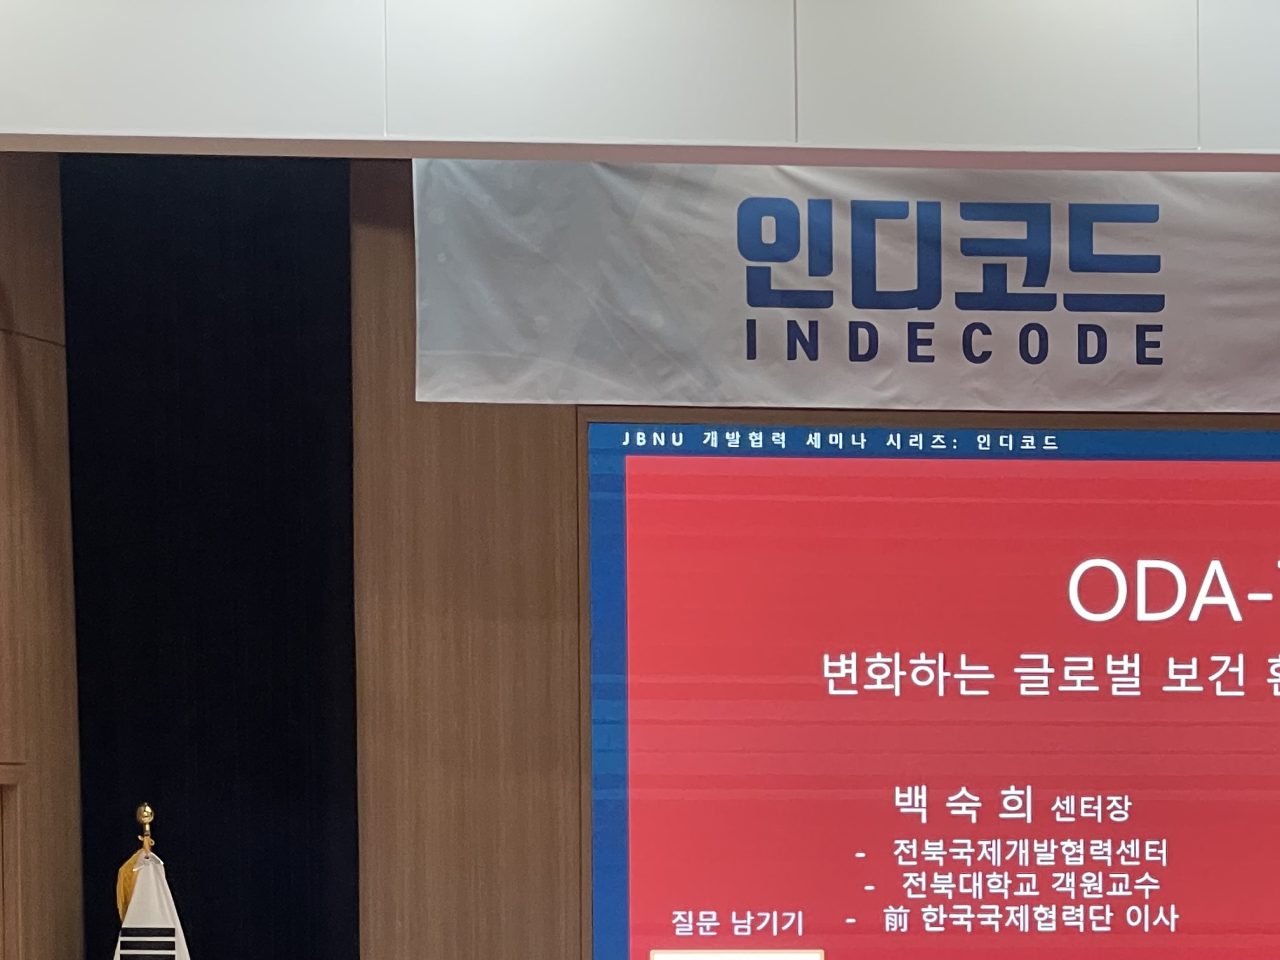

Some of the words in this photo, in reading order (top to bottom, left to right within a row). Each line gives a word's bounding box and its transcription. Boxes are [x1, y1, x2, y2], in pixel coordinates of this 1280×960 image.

[737, 198, 1165, 312] 인디코드
[747, 319, 1163, 365] INDECODE
[623, 432, 682, 446] JBNU
[703, 431, 785, 448] 개발협력
[806, 433, 866, 449] 세미나
[887, 433, 956, 449] 시리즈:
[977, 434, 1058, 450] 인디코드
[824, 652, 994, 696] 변화하는
[1014, 653, 1140, 695] 글로벌
[1163, 654, 1244, 696] 보건
[1051, 795, 1132, 822] 센터장
[894, 839, 1166, 866] 전북국제개발협력센터
[903, 872, 1039, 899] 전북대학교
[1052, 872, 1160, 899] 객원교수
[672, 911, 720, 935] 질문
[732, 911, 802, 936] 남기기
[884, 906, 910, 932] 前
[921, 905, 1113, 932] 한국국제협력단
[1127, 904, 1179, 932] 이사
